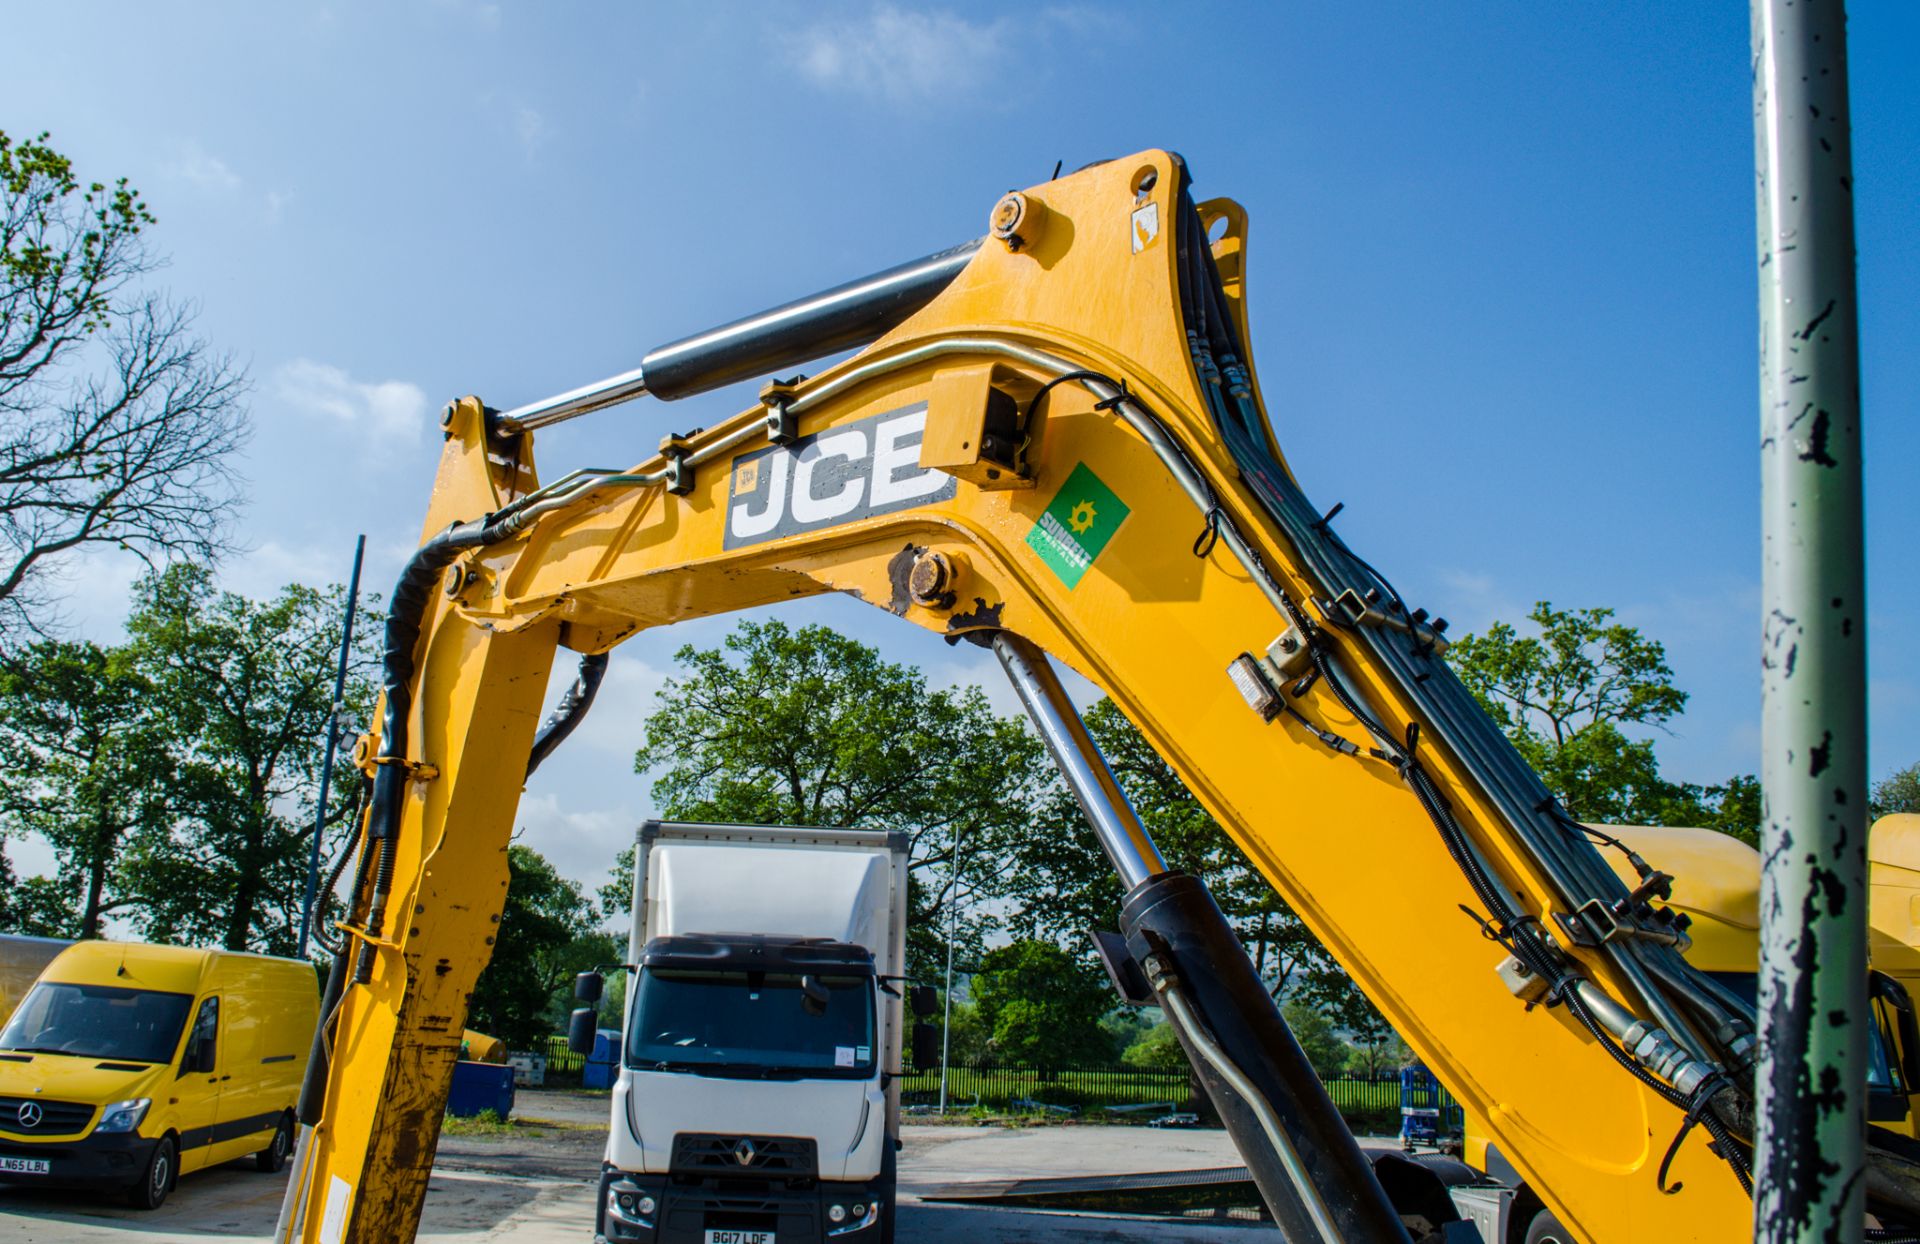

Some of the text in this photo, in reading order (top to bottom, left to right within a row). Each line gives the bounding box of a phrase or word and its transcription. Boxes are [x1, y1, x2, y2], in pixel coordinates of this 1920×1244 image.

[731, 410, 950, 538] JCB
[1039, 511, 1092, 570] SUNBELT
[1041, 530, 1075, 568] RENTALS
[27, 1160, 47, 1172] LBL
[713, 1231, 768, 1244] BG17 LDF
